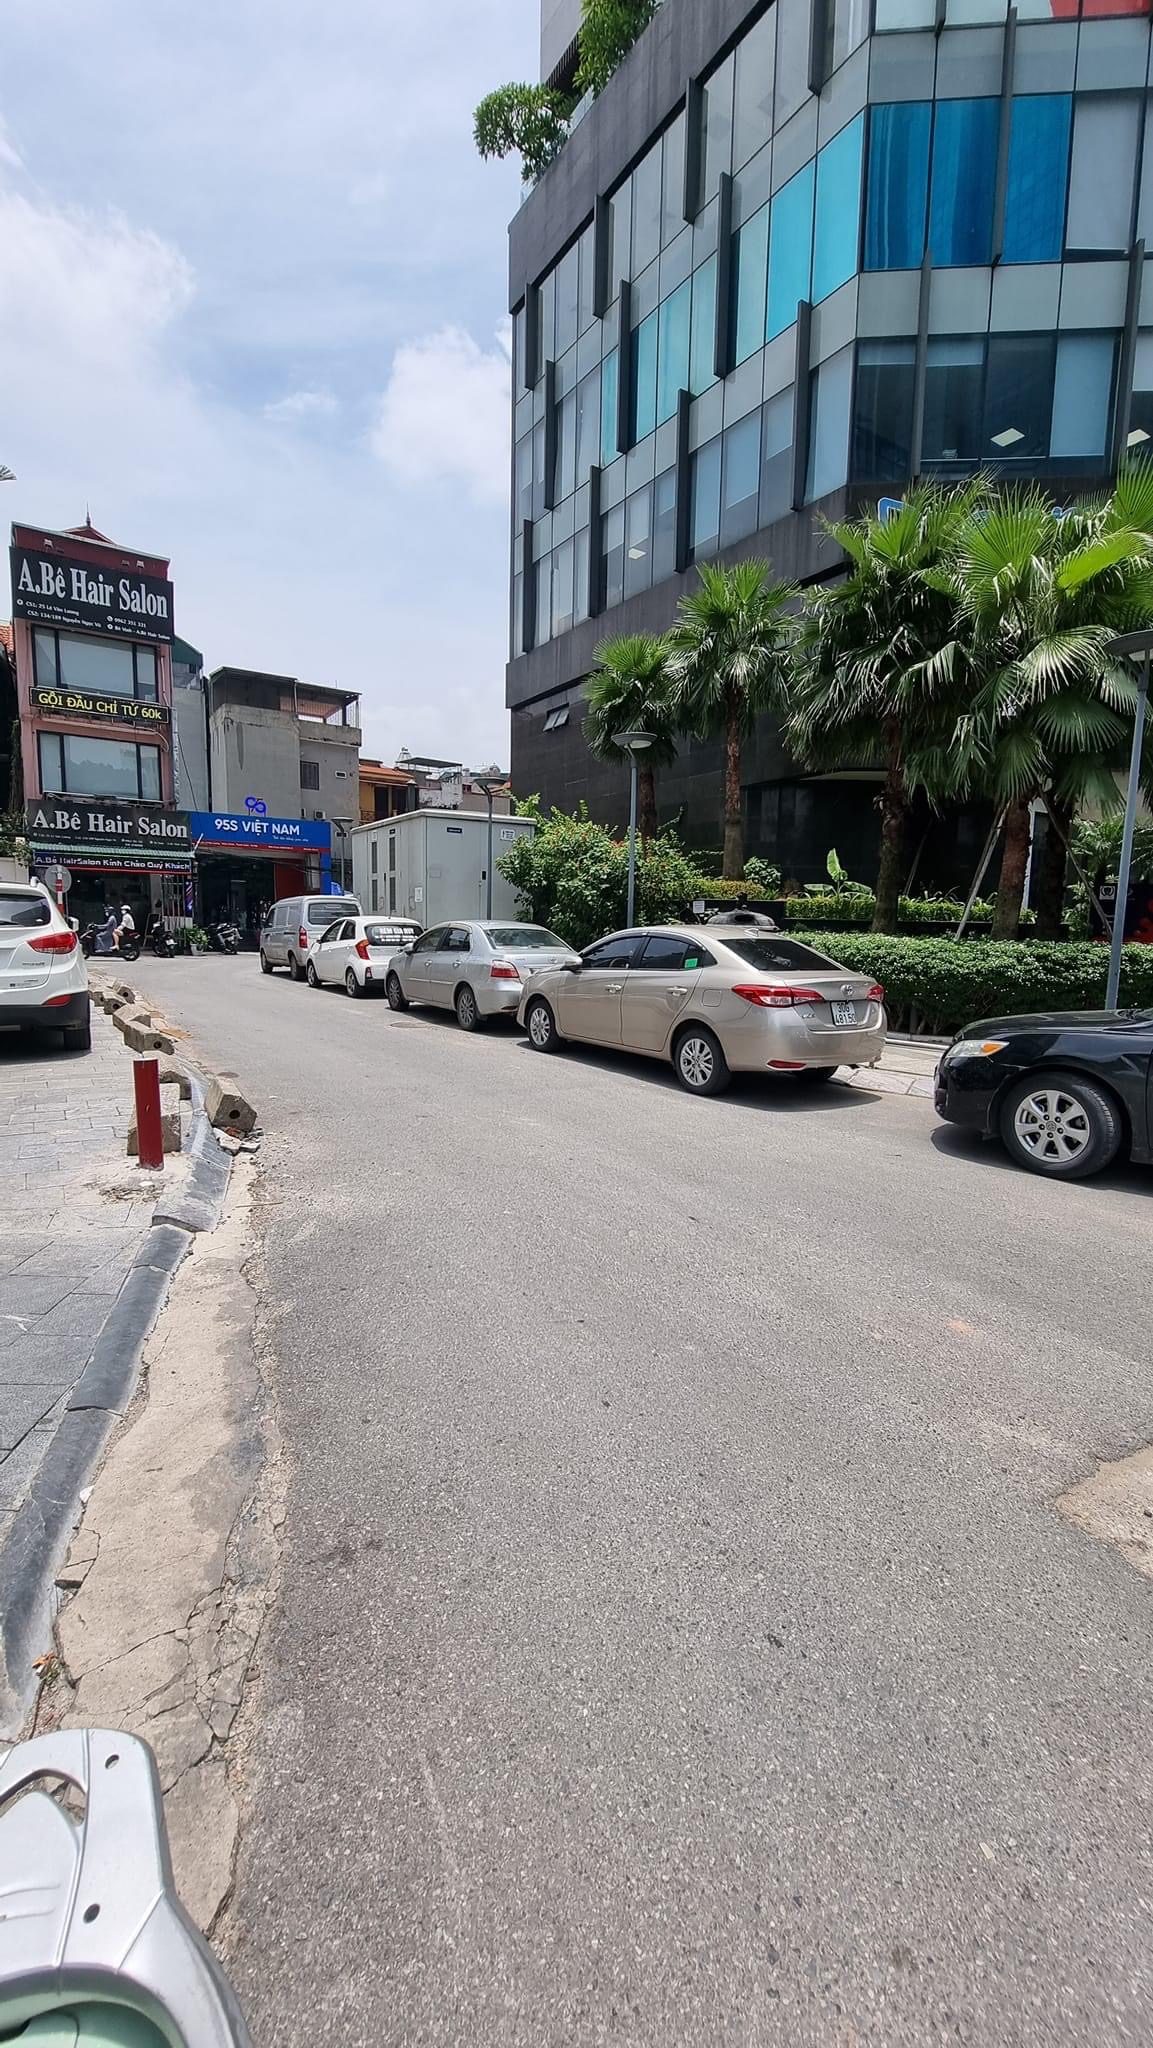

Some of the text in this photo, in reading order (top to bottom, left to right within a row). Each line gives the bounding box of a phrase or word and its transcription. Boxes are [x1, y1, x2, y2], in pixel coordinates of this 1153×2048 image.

[18, 558, 168, 619] A.Bê Hair Salon
[38, 690, 162, 720] GỘI ĐẦU CHỈ TỪ 60k
[32, 809, 188, 838] A.Bê Hair Salon
[214, 818, 300, 837] 95S VIỆT NAM
